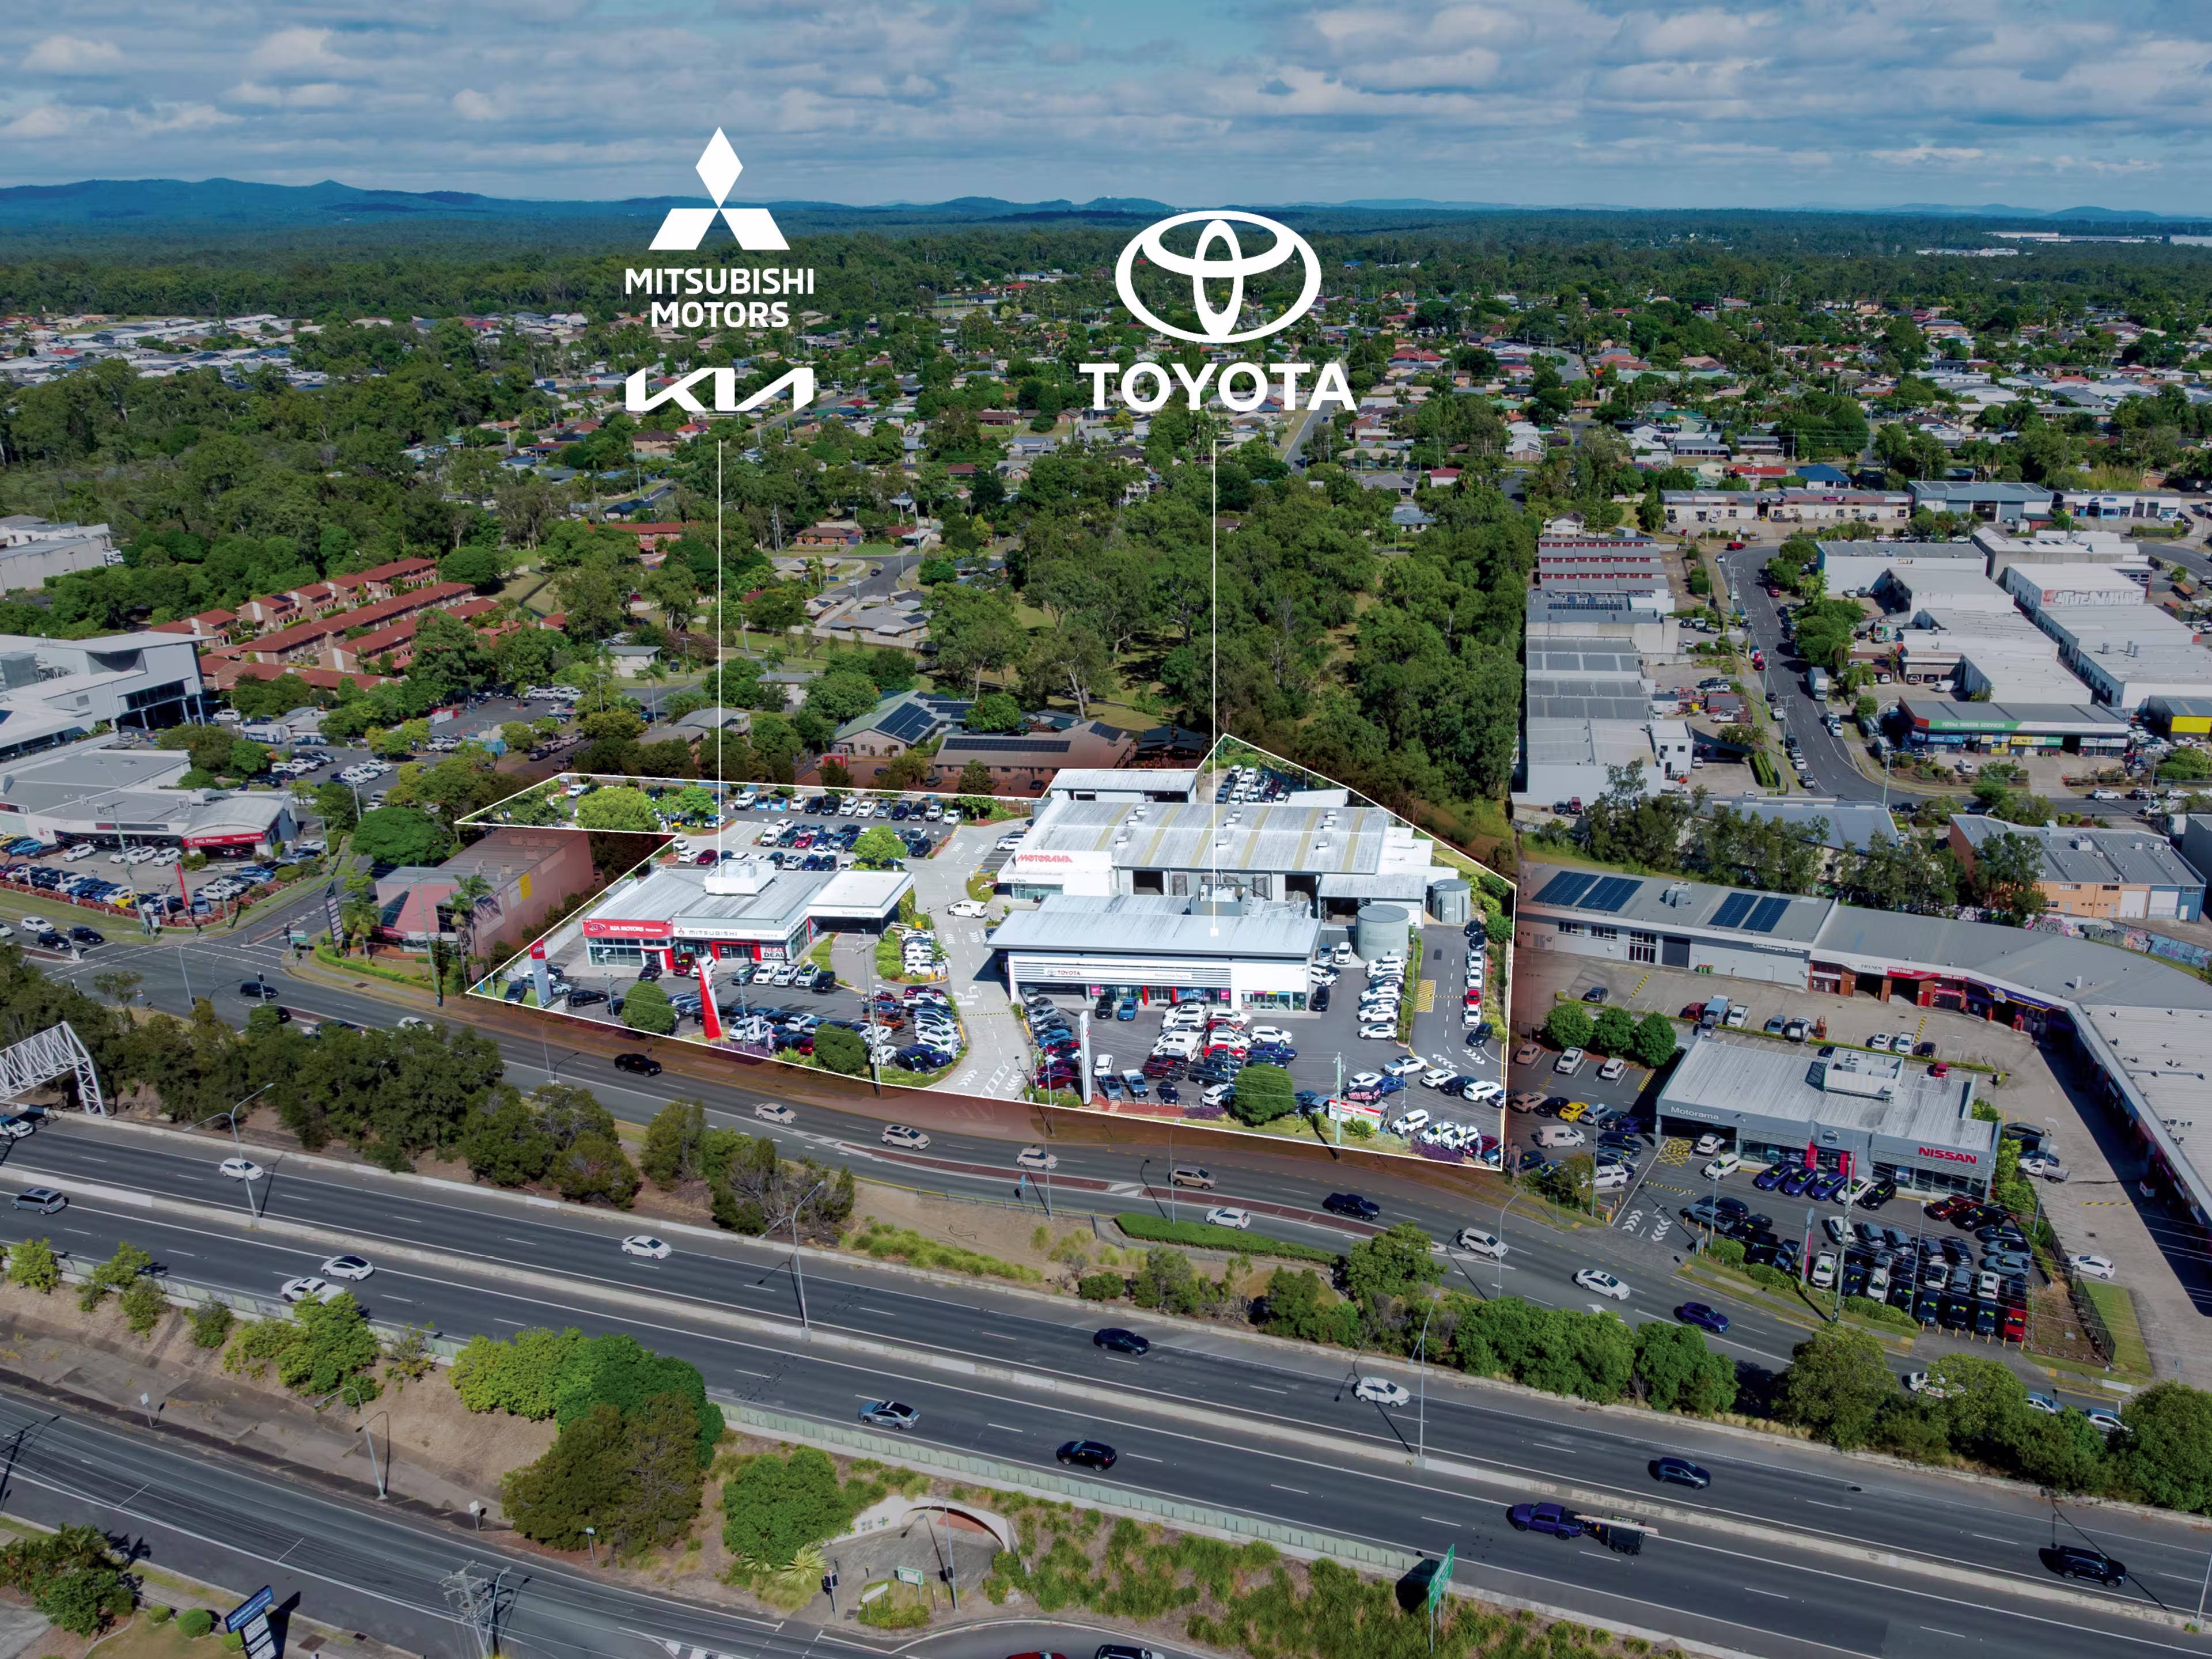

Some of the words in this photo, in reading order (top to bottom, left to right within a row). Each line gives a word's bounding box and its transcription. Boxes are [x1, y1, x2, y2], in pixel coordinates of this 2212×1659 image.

[1016, 854, 1073, 863] MOTORAMA
[1671, 1107, 1719, 1120] Motorama
[1919, 1146, 1977, 1164] NISSAN
